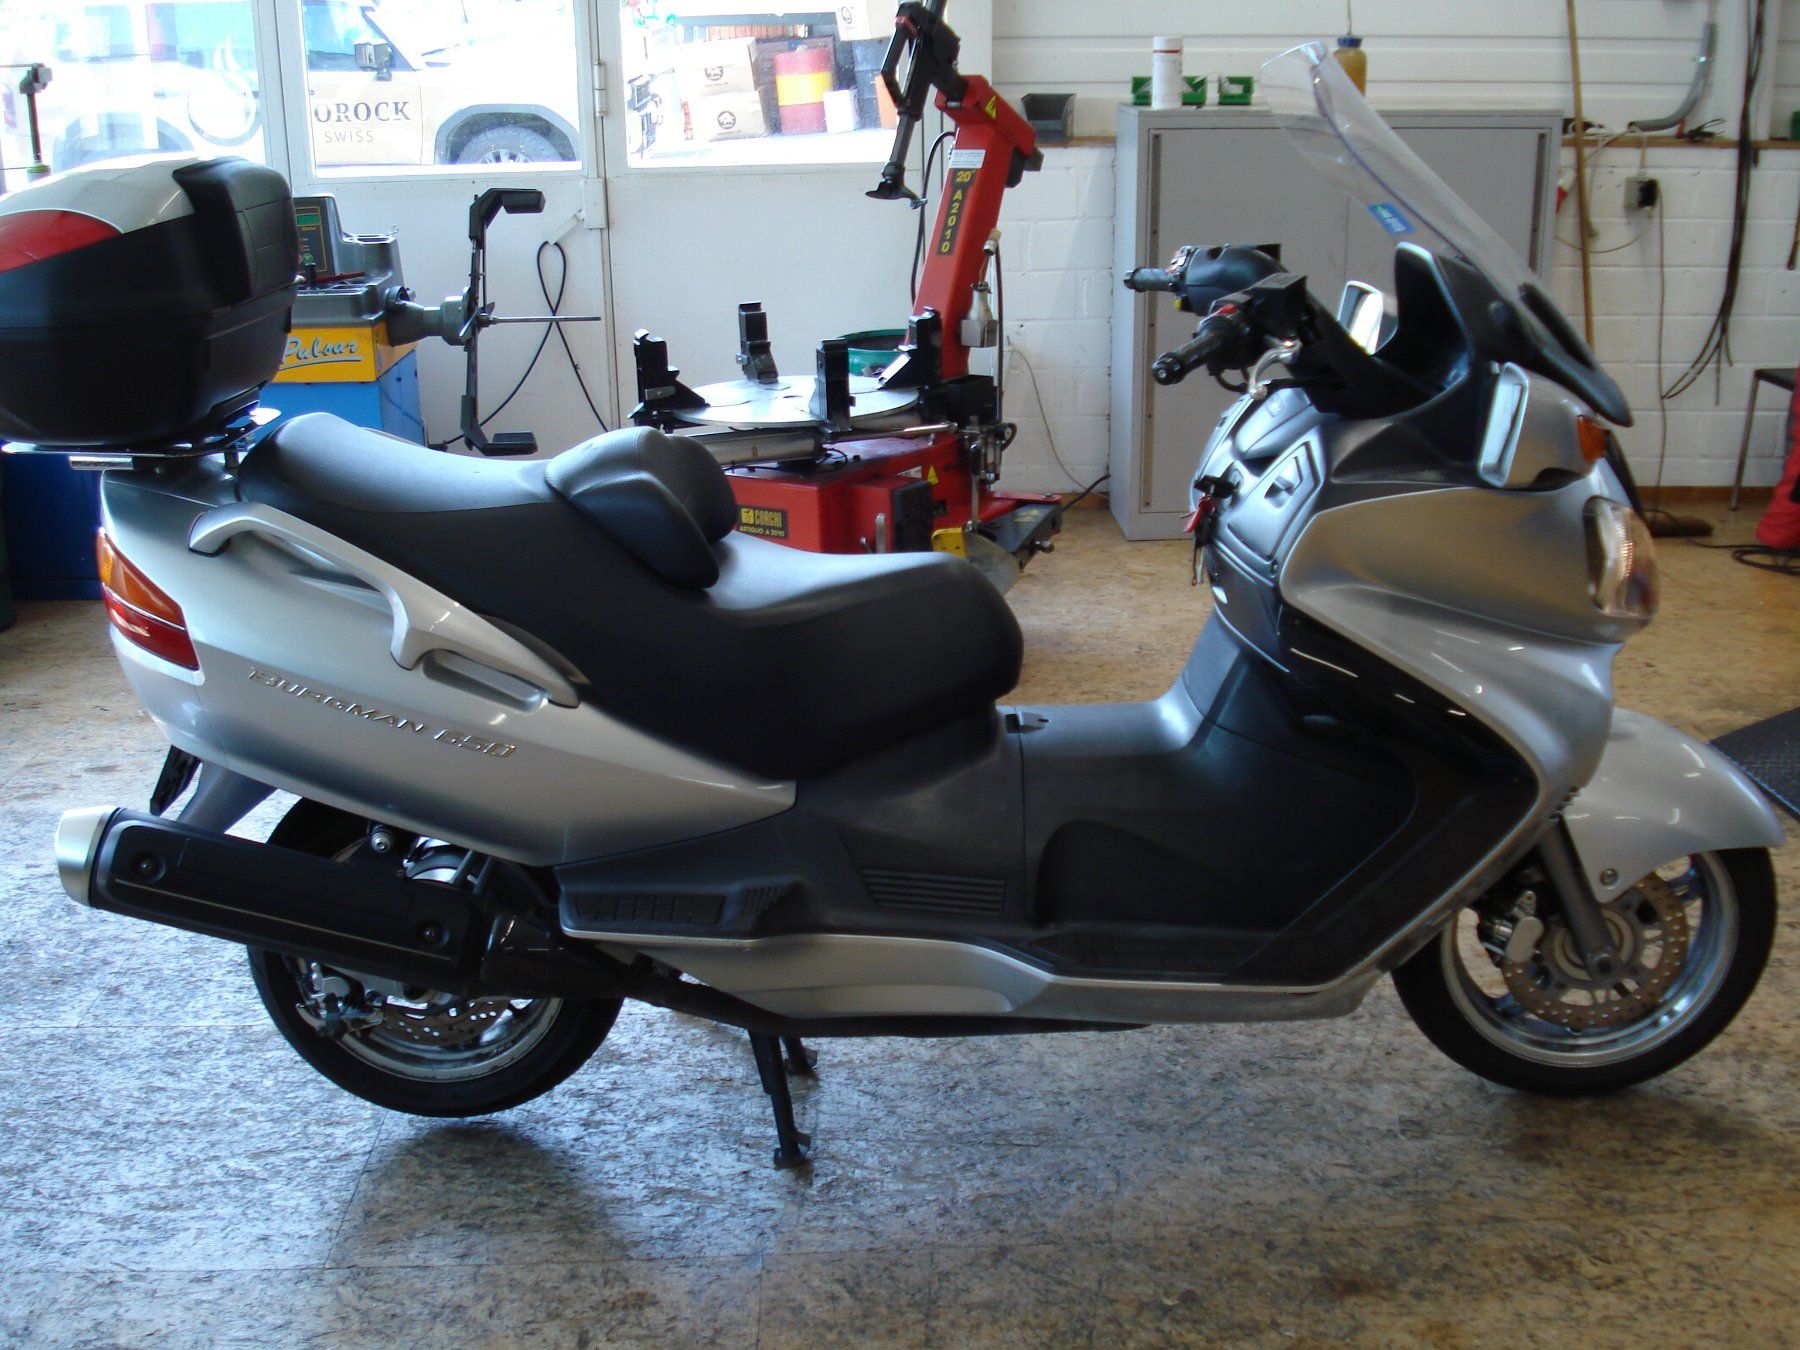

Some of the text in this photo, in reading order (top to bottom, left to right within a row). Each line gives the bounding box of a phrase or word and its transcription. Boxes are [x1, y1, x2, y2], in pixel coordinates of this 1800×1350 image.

[324, 130, 374, 143] SWISS
[941, 189, 962, 253] A2010
[281, 336, 358, 363] Pulsar
[248, 666, 516, 759] BURGMAN 650
